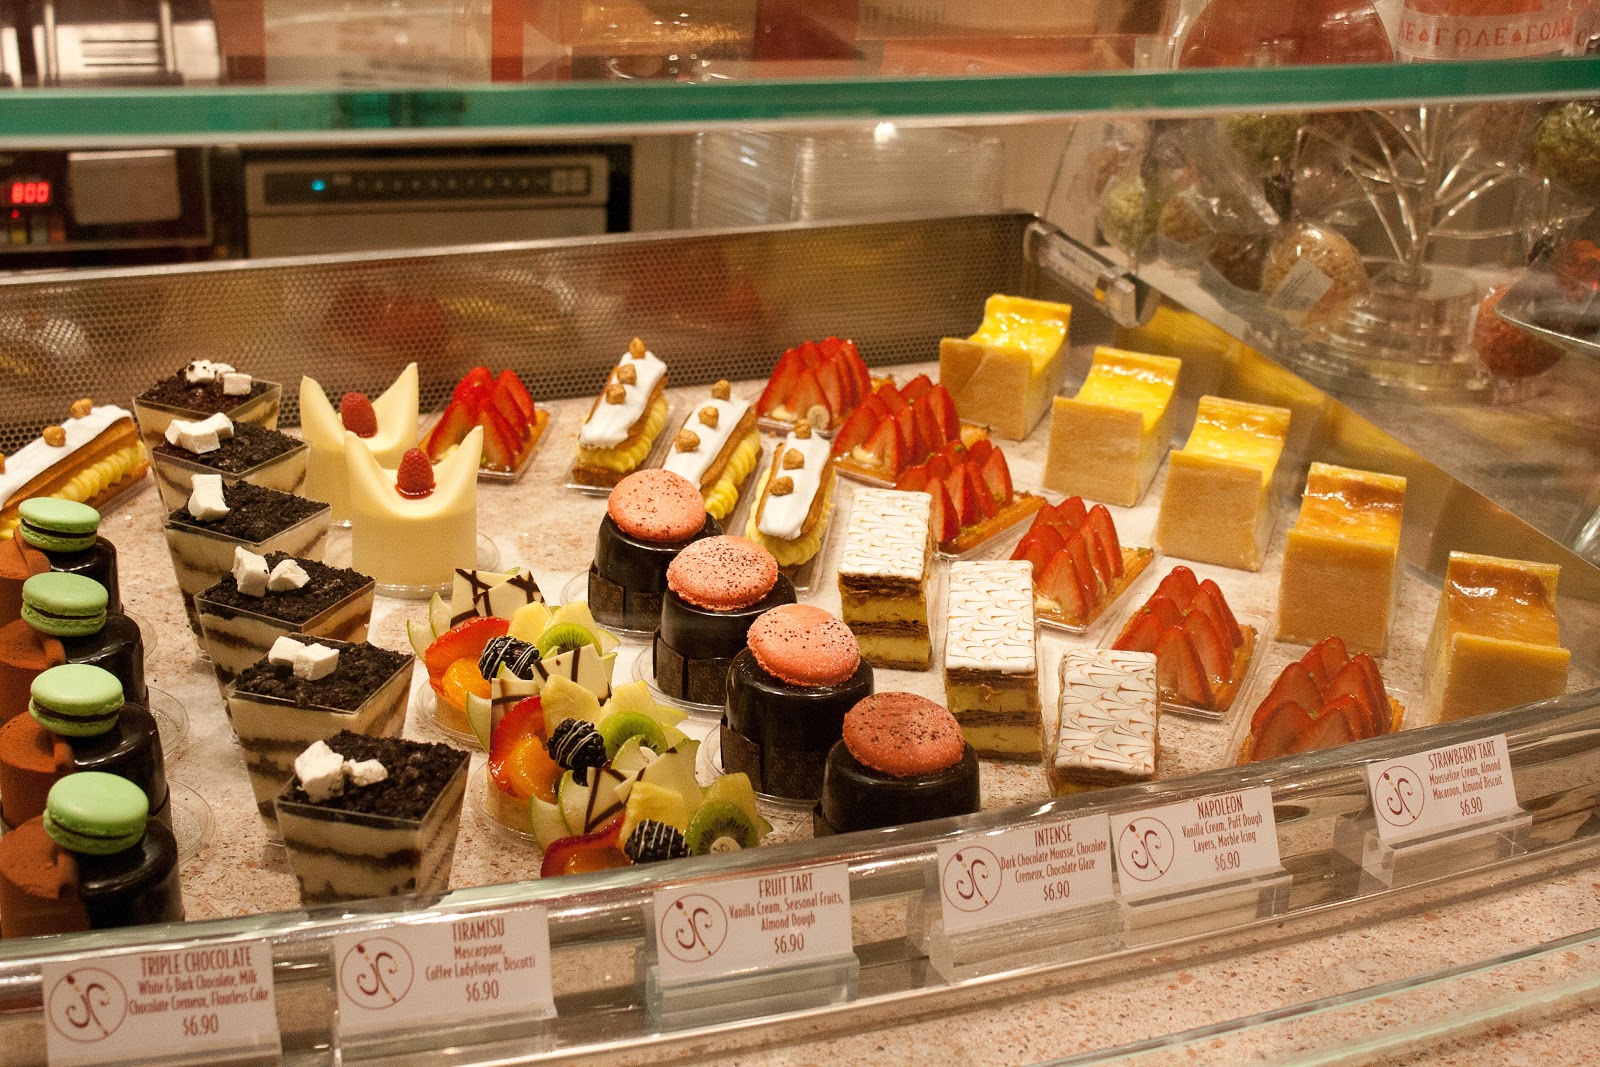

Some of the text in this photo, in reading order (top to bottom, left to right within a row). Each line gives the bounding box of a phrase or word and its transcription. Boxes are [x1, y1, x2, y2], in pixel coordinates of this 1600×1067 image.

[1428, 740, 1496, 770] STRAWBERRY TART
[1428, 758, 1501, 786] Mousseline Cream, Almond
[1462, 779, 1484, 793] Almond
[1484, 774, 1504, 788] Biscuit
[1197, 795, 1244, 819] NAPOLEON
[1459, 796, 1483, 816] $6.90
[1034, 824, 1072, 847] INTENSE
[1181, 811, 1263, 838] Vanilla Cream, Puff Dough
[1193, 830, 1257, 853] Layers, Marble Icing
[1001, 839, 1107, 870] Dark Chocolate Mousse, Chocolate
[1214, 850, 1241, 871] $6.90
[1015, 858, 1096, 883] Cremeux, Chocolate Glaze
[758, 872, 814, 897] FRUIT TART
[1043, 880, 1071, 902] $6.90
[729, 891, 844, 918] Vanilla Cream, Seasonal Fruits,
[451, 917, 505, 941] TIRAMISU
[761, 912, 816, 931] Almond Dough
[774, 932, 805, 954] $6.90
[140, 945, 253, 976] TRIPLE CHOCOLATE
[425, 964, 453, 981] Coffee
[503, 954, 537, 971] Biscotti
[138, 979, 164, 994] White
[239, 968, 257, 984] Milk
[466, 979, 500, 1002] $6.90
[249, 986, 270, 1002] Cake
[182, 1012, 219, 1036] $6.90
